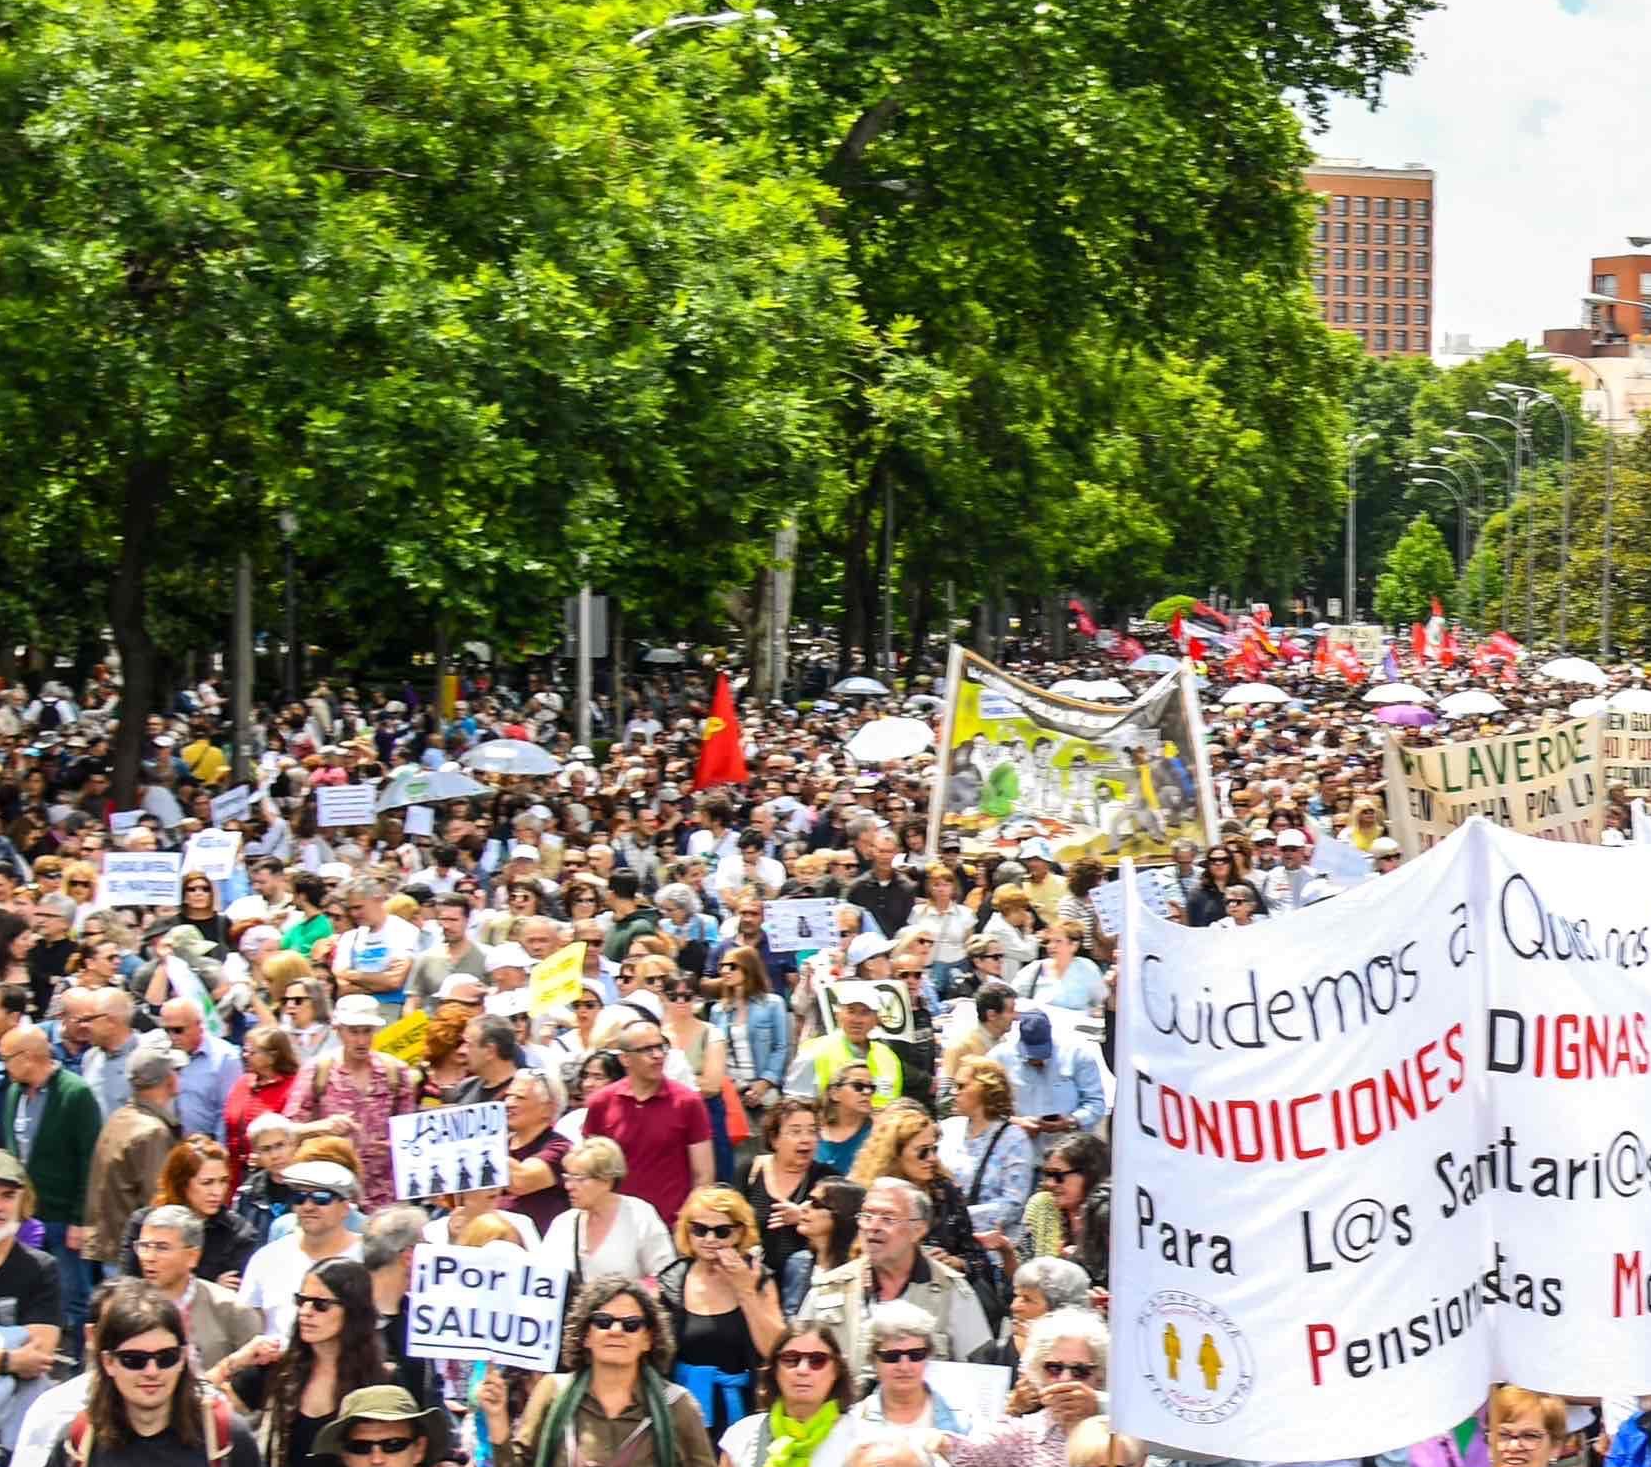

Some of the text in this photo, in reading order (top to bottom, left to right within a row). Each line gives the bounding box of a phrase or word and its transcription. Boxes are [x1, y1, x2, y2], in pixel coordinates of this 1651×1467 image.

[1140, 940, 1422, 1051] Cuidemos
[1134, 1022, 1466, 1164] CONDICIONES
[1485, 1009, 1649, 1080] DIGNAS
[418, 1255, 557, 1300] ¡Por la
[1135, 1184, 1237, 1277] Para
[1301, 1197, 1414, 1273] L@s
[412, 1303, 554, 1351] SALUD!
[1306, 1241, 1562, 1387] Pensionstas
